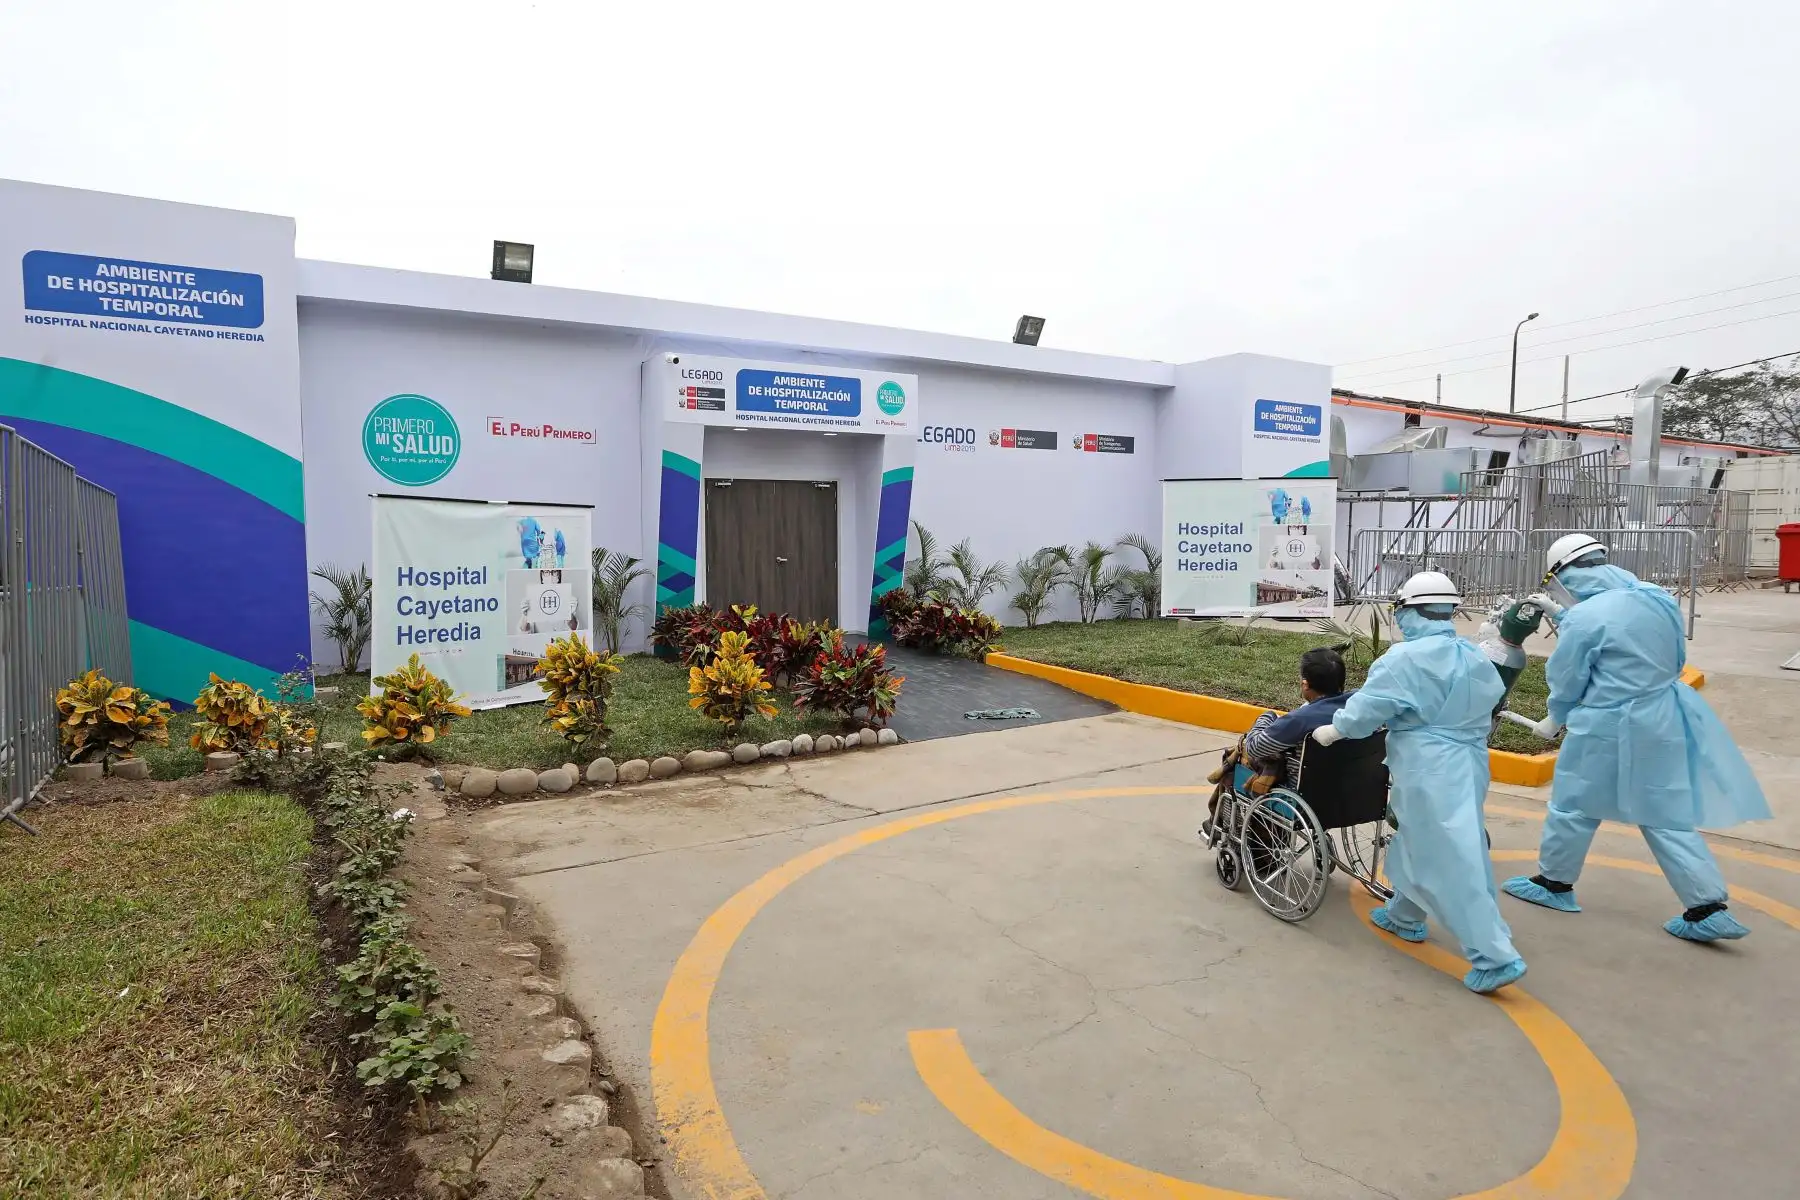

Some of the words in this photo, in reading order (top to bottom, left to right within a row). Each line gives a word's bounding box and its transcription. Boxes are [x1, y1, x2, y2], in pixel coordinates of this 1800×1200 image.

[96, 263, 196, 286] AMBIENTE
[47, 275, 74, 291] DE
[79, 278, 244, 307] HOSPITALIZACIÓN
[99, 297, 203, 319] TEMPORAL
[25, 315, 87, 328] HOSPITAL
[90, 320, 152, 333] NACIONAL
[154, 326, 214, 338] CAYETANO
[216, 331, 265, 342] HEREDIA
[682, 369, 723, 381] LEGADO
[773, 376, 826, 388] AMBIENTE
[748, 385, 762, 396] DE
[764, 387, 850, 402] HOSPITALIZACIÓN
[884, 395, 904, 404] SALUD
[774, 399, 829, 412] TEMPORAL
[1274, 404, 1303, 414] AMBIENTE
[374, 417, 434, 434] PRIMERO
[735, 414, 768, 422] HOSPITAL
[769, 416, 801, 424] NACIONAL
[1261, 412, 1269, 420] DE
[1269, 412, 1316, 425] HOSPITALIZACIÓN
[1275, 422, 1304, 432] TEMPORAL
[375, 432, 390, 445] MI
[392, 433, 454, 456] SALUD
[917, 426, 976, 445] EGADO
[944, 443, 960, 452] Lima
[1178, 522, 1244, 538] Hospital
[1178, 540, 1253, 557] Cayetano
[1178, 558, 1238, 571] Heredia
[397, 566, 488, 590] Hospital
[397, 595, 499, 620] Cayetano
[397, 622, 481, 646] Heredia
